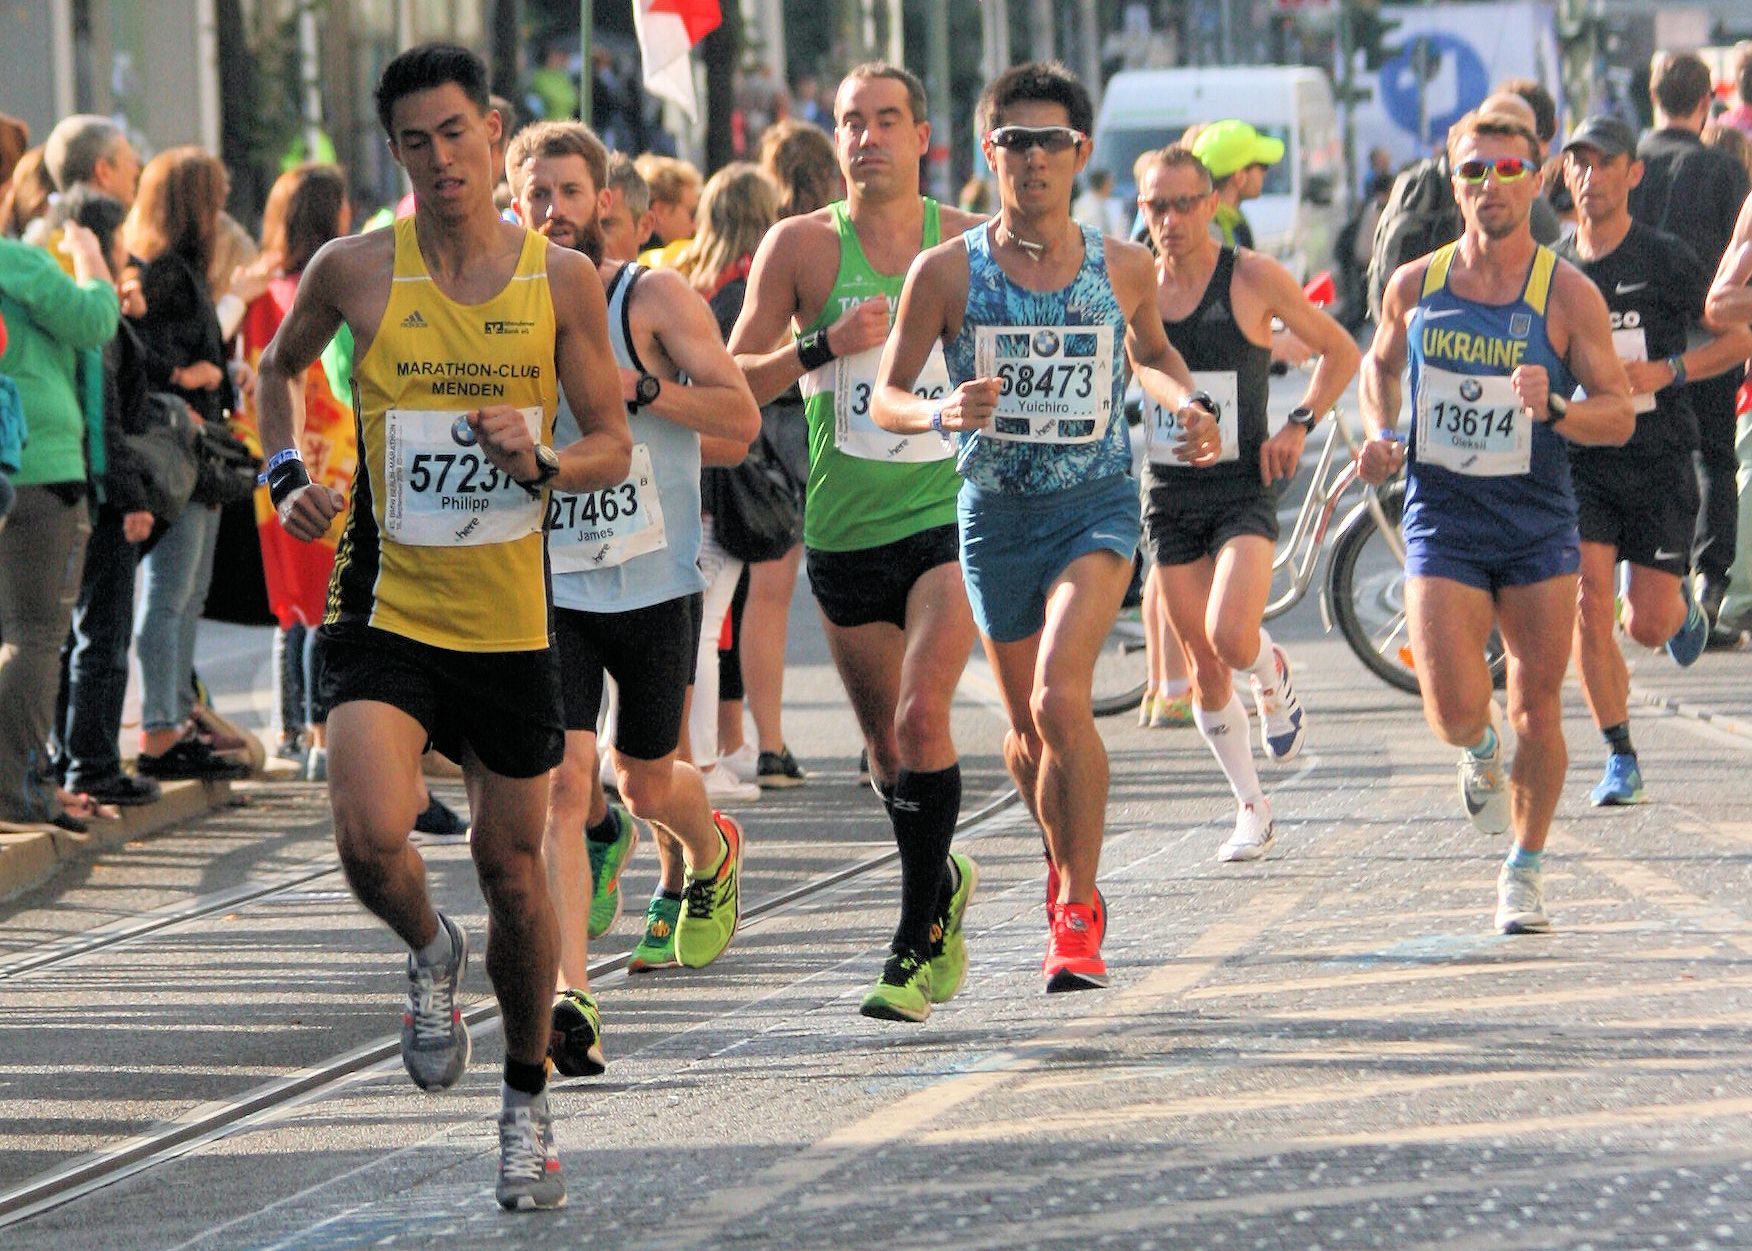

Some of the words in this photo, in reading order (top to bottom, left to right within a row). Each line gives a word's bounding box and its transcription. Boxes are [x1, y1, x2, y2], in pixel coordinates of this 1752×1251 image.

[397, 362, 540, 379] MARATHON-CLUB
[432, 382, 504, 396] MENDEN
[997, 364, 1093, 398] 68473
[1018, 401, 1069, 413] Yuichiro
[1434, 402, 1515, 438] 13614
[640, 478, 648, 486] B
[442, 496, 489, 512] Philipp
[550, 483, 638, 530] 27463
[455, 517, 480, 541] here
[577, 527, 614, 542] James
